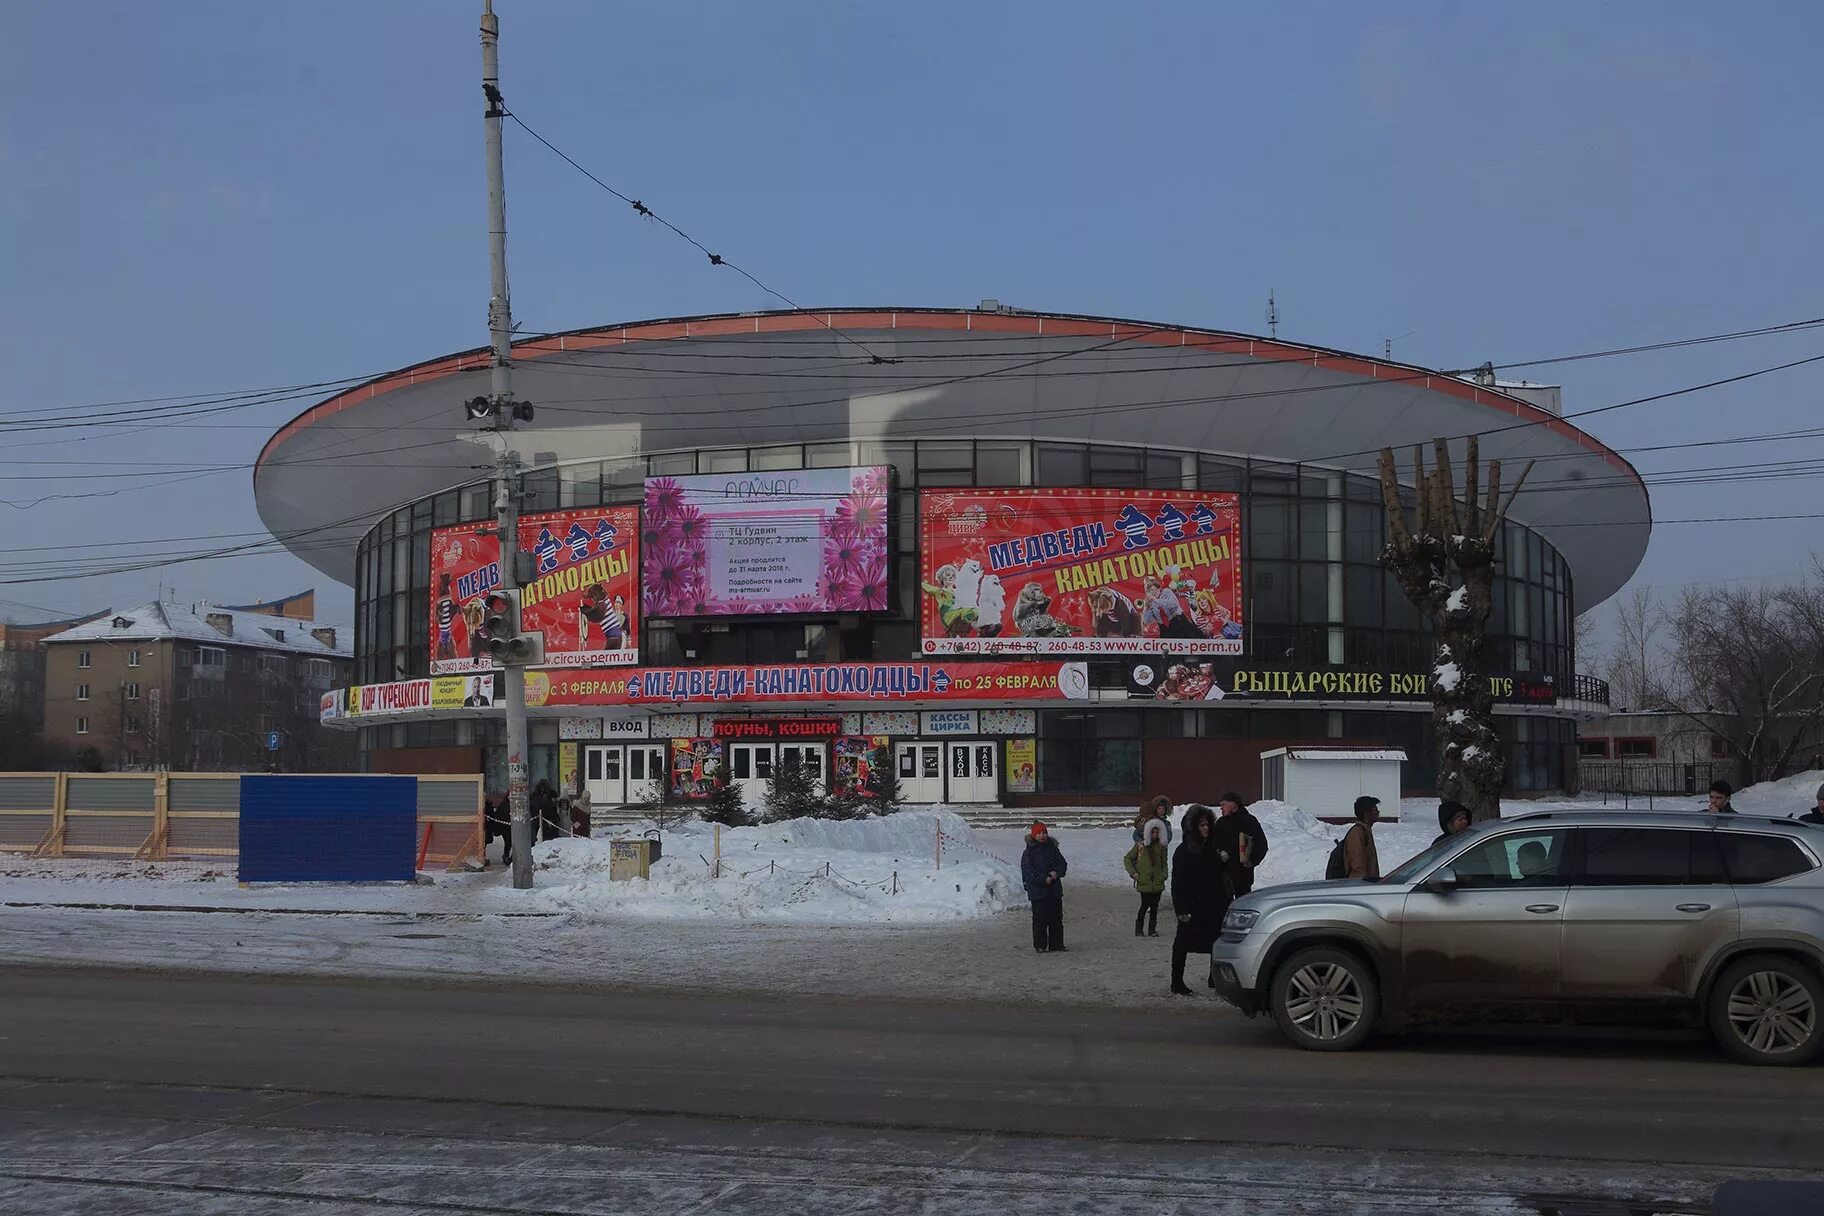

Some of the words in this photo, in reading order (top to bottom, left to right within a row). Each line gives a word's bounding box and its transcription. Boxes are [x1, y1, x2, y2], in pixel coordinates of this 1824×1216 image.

[725, 478, 799, 498] АРМУАР
[729, 527, 742, 536] ТЦ
[744, 527, 777, 536] Гудвин
[729, 537, 735, 545] 2
[737, 537, 773, 546] корпус,
[776, 536, 782, 544] 2
[785, 535, 809, 544] этаж
[751, 556, 786, 564] продлится
[1054, 535, 1230, 595] КАНАТОХОДЦЫ
[457, 562, 501, 601] МЕДВ
[729, 578, 773, 586] Подробности
[784, 576, 803, 584] сайте
[729, 586, 771, 594] ms-armuar.ru
[1048, 641, 1102, 651] 260-48-53
[1104, 639, 1241, 652] www.circus-perm.ru
[551, 685, 558, 696] с
[561, 682, 568, 696] 3
[571, 680, 625, 696] ФЕВРАЛЯ
[643, 666, 929, 700] МЕДВЕДИ-КАНАТОХОДЦЫ
[955, 679, 972, 690] по
[975, 676, 991, 689] 25
[995, 675, 1057, 689] ФЕВРАЛЯ
[1232, 670, 1384, 698] РЫЦАРСКИЕ
[1390, 673, 1426, 694] БОИ
[352, 688, 358, 704] 6
[361, 687, 376, 711] ХОР
[378, 681, 431, 710] ТУРЕЦКОГО
[930, 713, 970, 722] КАССЫ
[610, 722, 643, 733] ВХОД
[930, 722, 971, 732] ЦИРКА
[957, 747, 965, 777] ВХОД
